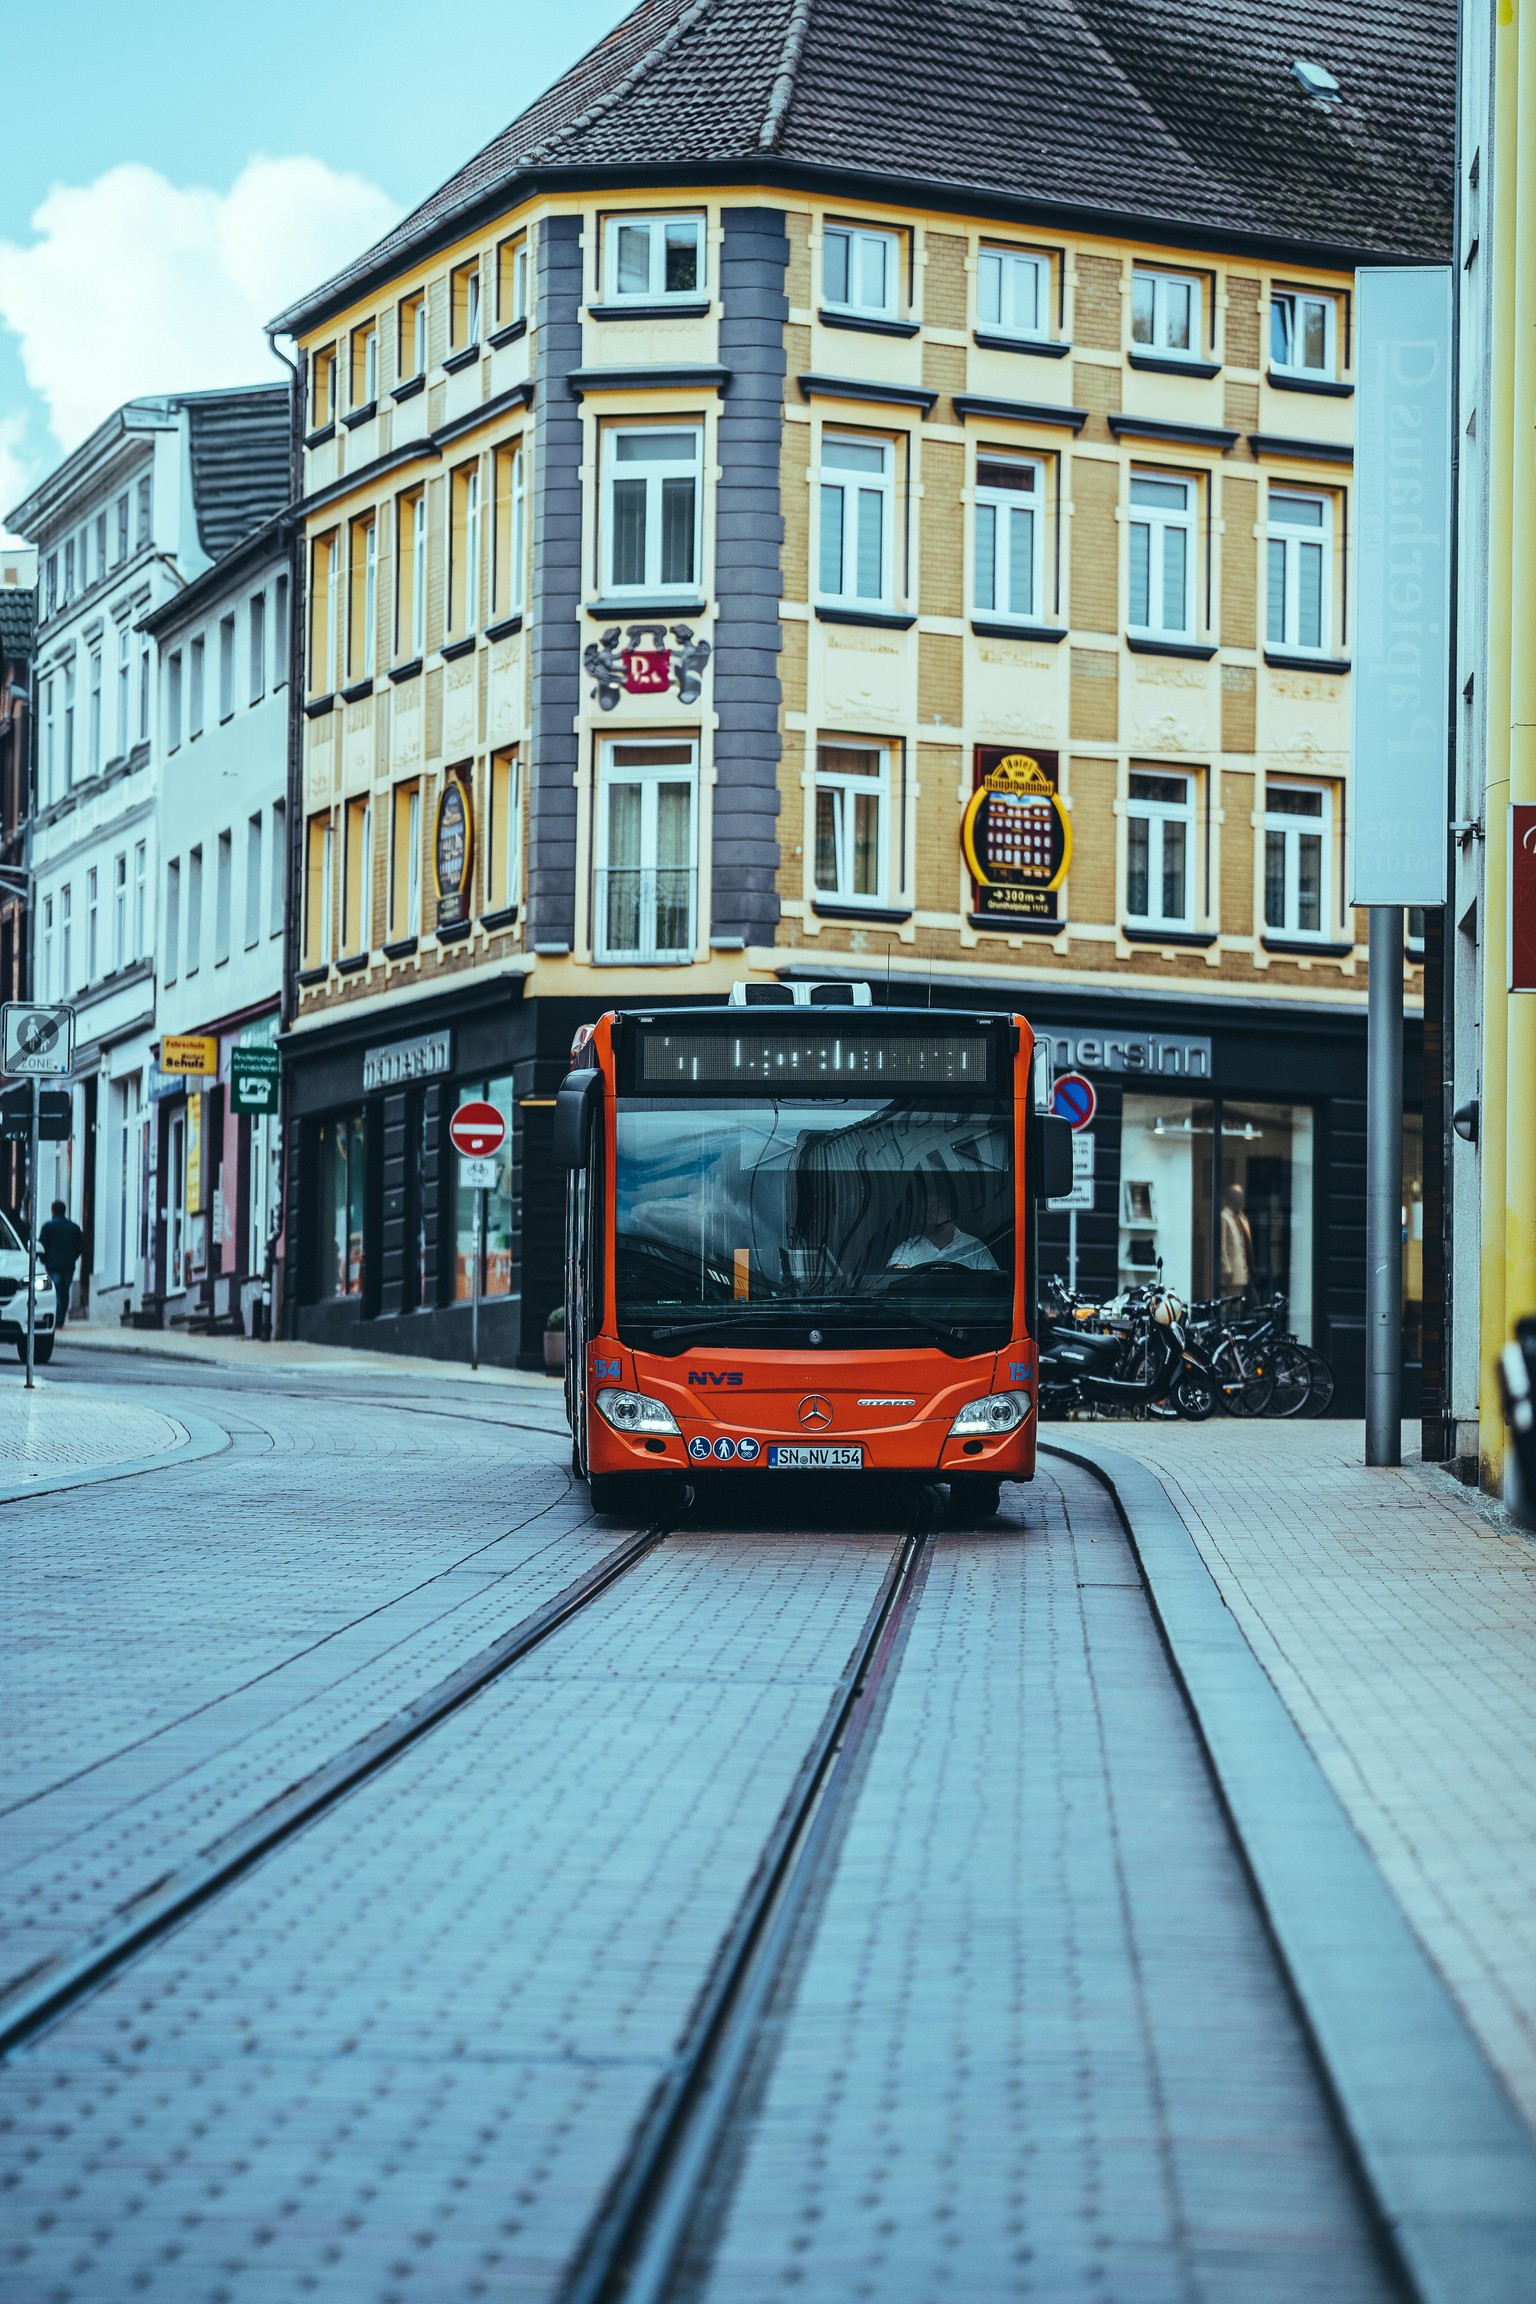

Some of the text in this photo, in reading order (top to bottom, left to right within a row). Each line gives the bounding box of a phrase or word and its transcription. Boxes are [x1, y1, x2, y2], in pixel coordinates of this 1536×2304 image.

[1053, 1035, 1207, 1075] nersinn
[594, 1359, 621, 1379] 154
[687, 1371, 744, 1386] NVS
[1008, 1362, 1033, 1381] 154
[779, 1449, 799, 1464] SN
[809, 1449, 829, 1464] NV
[832, 1449, 860, 1464] 154
